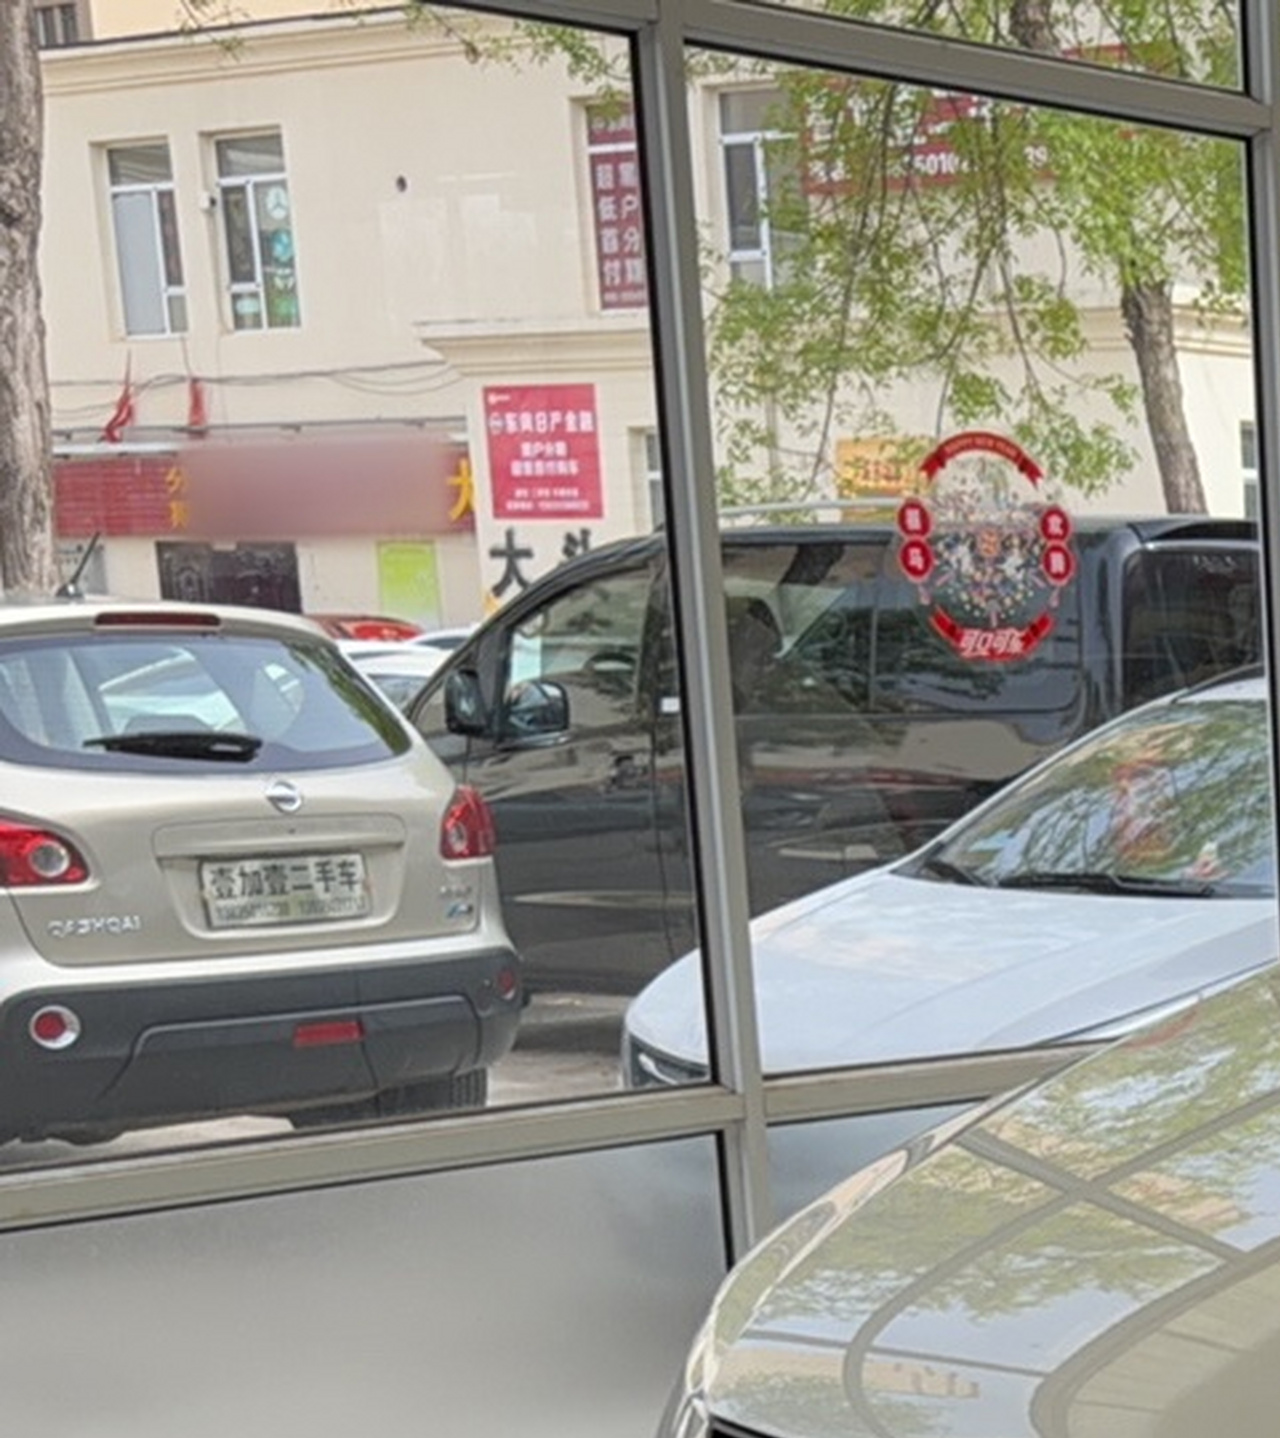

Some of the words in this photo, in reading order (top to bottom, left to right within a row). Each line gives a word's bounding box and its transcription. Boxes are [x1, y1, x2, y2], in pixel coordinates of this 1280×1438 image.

[209, 861, 360, 899] 壹加壹二手车
